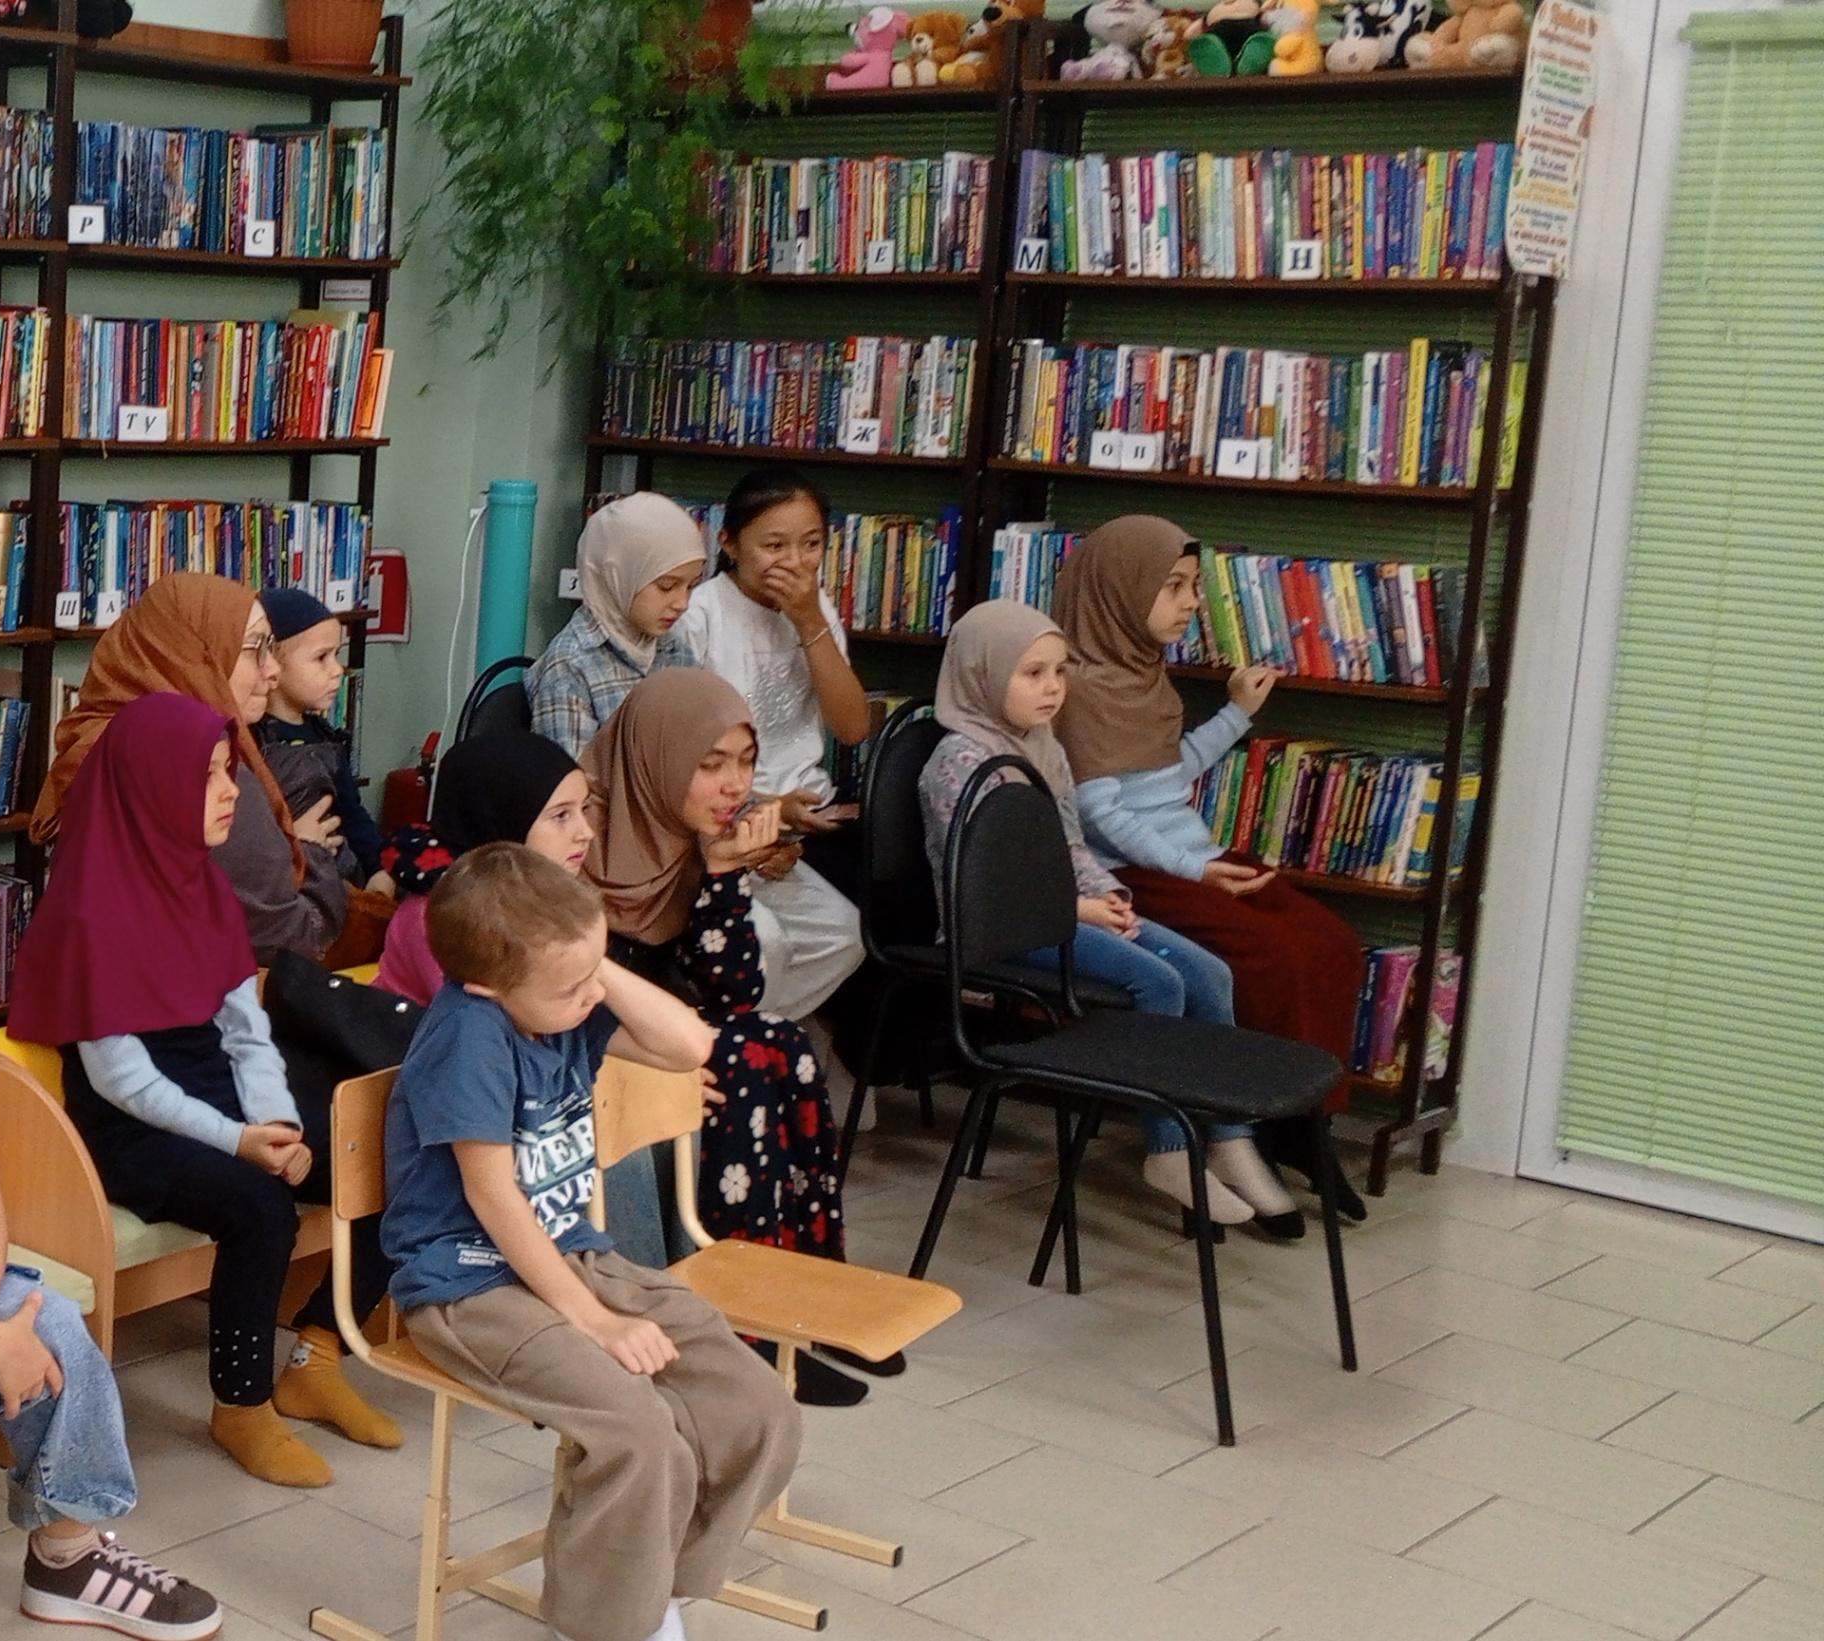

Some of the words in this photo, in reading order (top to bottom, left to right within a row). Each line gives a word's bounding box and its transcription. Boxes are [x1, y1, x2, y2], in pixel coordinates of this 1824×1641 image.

[79, 217, 93, 234] Р
[252, 228, 266, 245] С
[1018, 245, 1045, 270] М
[1289, 247, 1313, 271] Н
[127, 413, 139, 430] Т
[146, 415, 158, 433] У
[852, 426, 876, 442] Ж
[1101, 443, 1113, 457] О
[1234, 450, 1247, 465] Р
[60, 600, 77, 616] Ш
